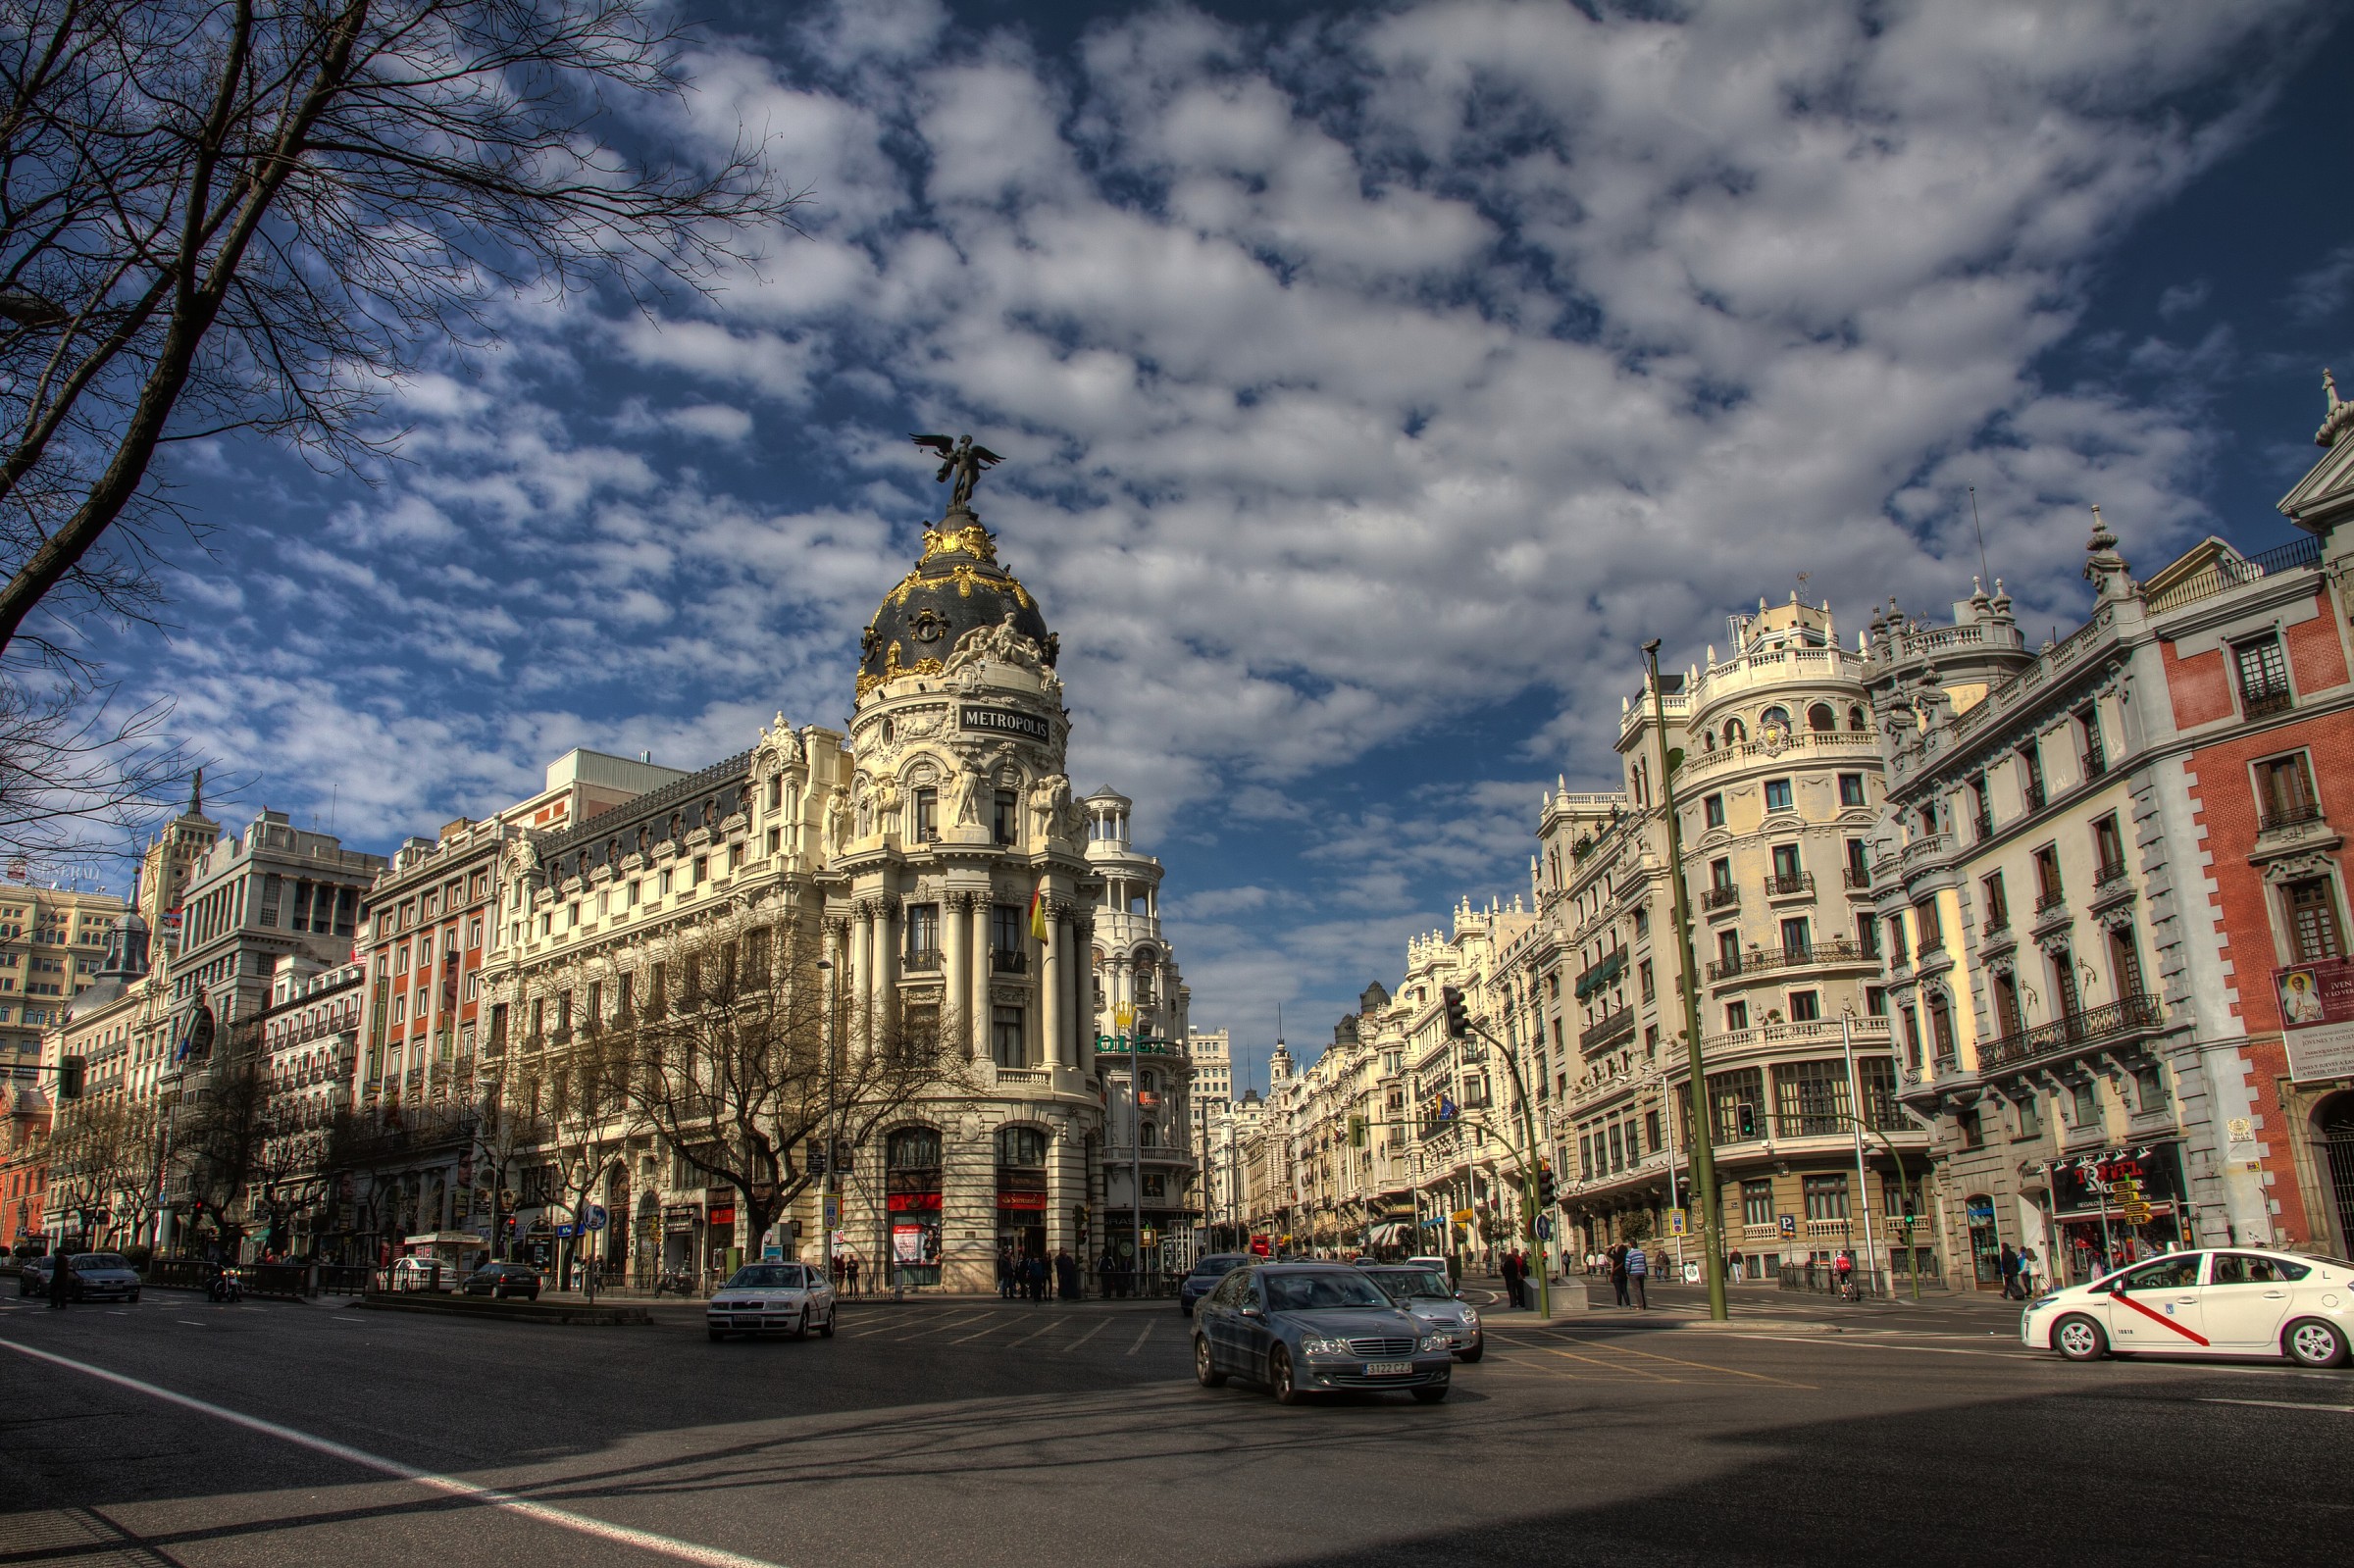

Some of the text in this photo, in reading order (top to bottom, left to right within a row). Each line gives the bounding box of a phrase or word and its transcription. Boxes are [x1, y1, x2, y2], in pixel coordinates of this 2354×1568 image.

[966, 711, 1048, 736] METROPOLIS
[37, 862, 101, 881] NERALI
[2330, 981, 2352, 989] ¡VEN
[1097, 1035, 1170, 1053] OLEX
[1010, 1195, 1041, 1204] Santander
[1781, 1217, 1792, 1229] P
[1368, 1363, 1410, 1374] 3122 CZJ
